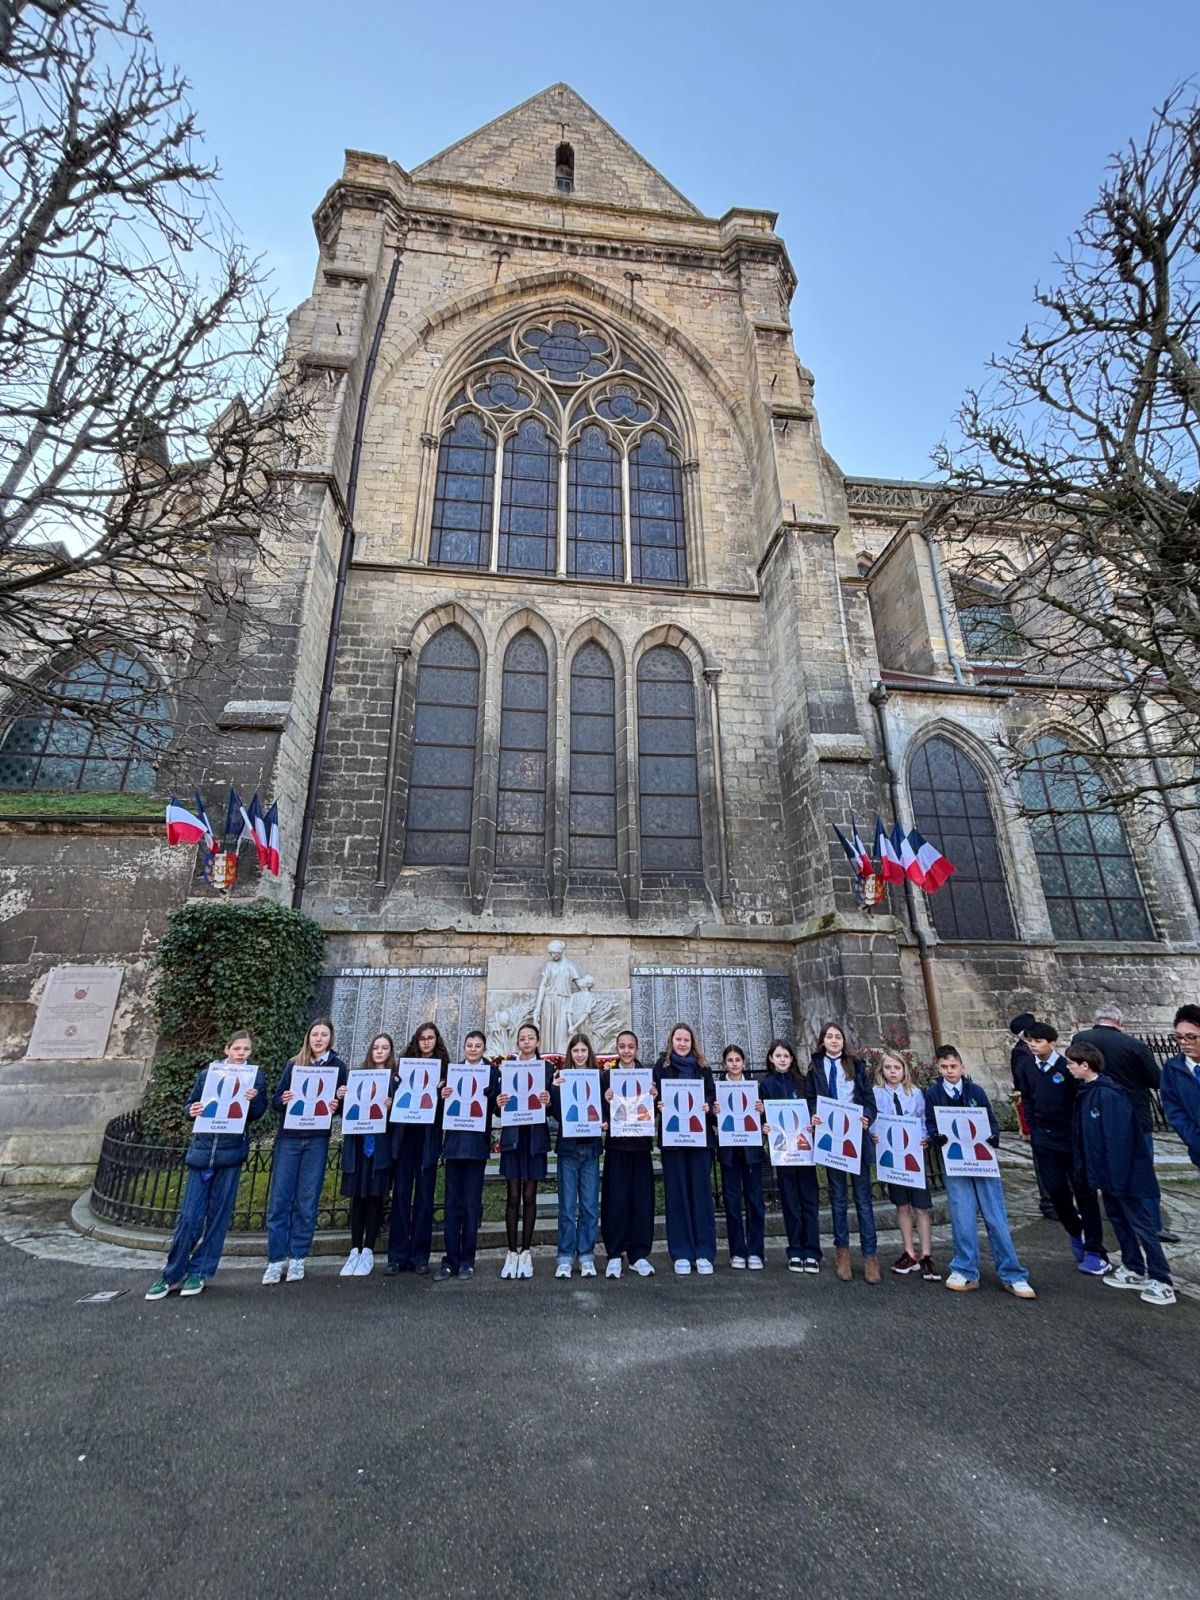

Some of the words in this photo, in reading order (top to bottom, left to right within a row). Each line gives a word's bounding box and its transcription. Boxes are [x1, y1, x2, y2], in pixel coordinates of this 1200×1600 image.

[343, 968, 355, 976] LA
[362, 968, 390, 976] VILLE
[399, 968, 410, 976] DE
[647, 968, 664, 976] SES
[671, 967, 705, 976] MORTS
[713, 967, 763, 976] GLORIEUX
